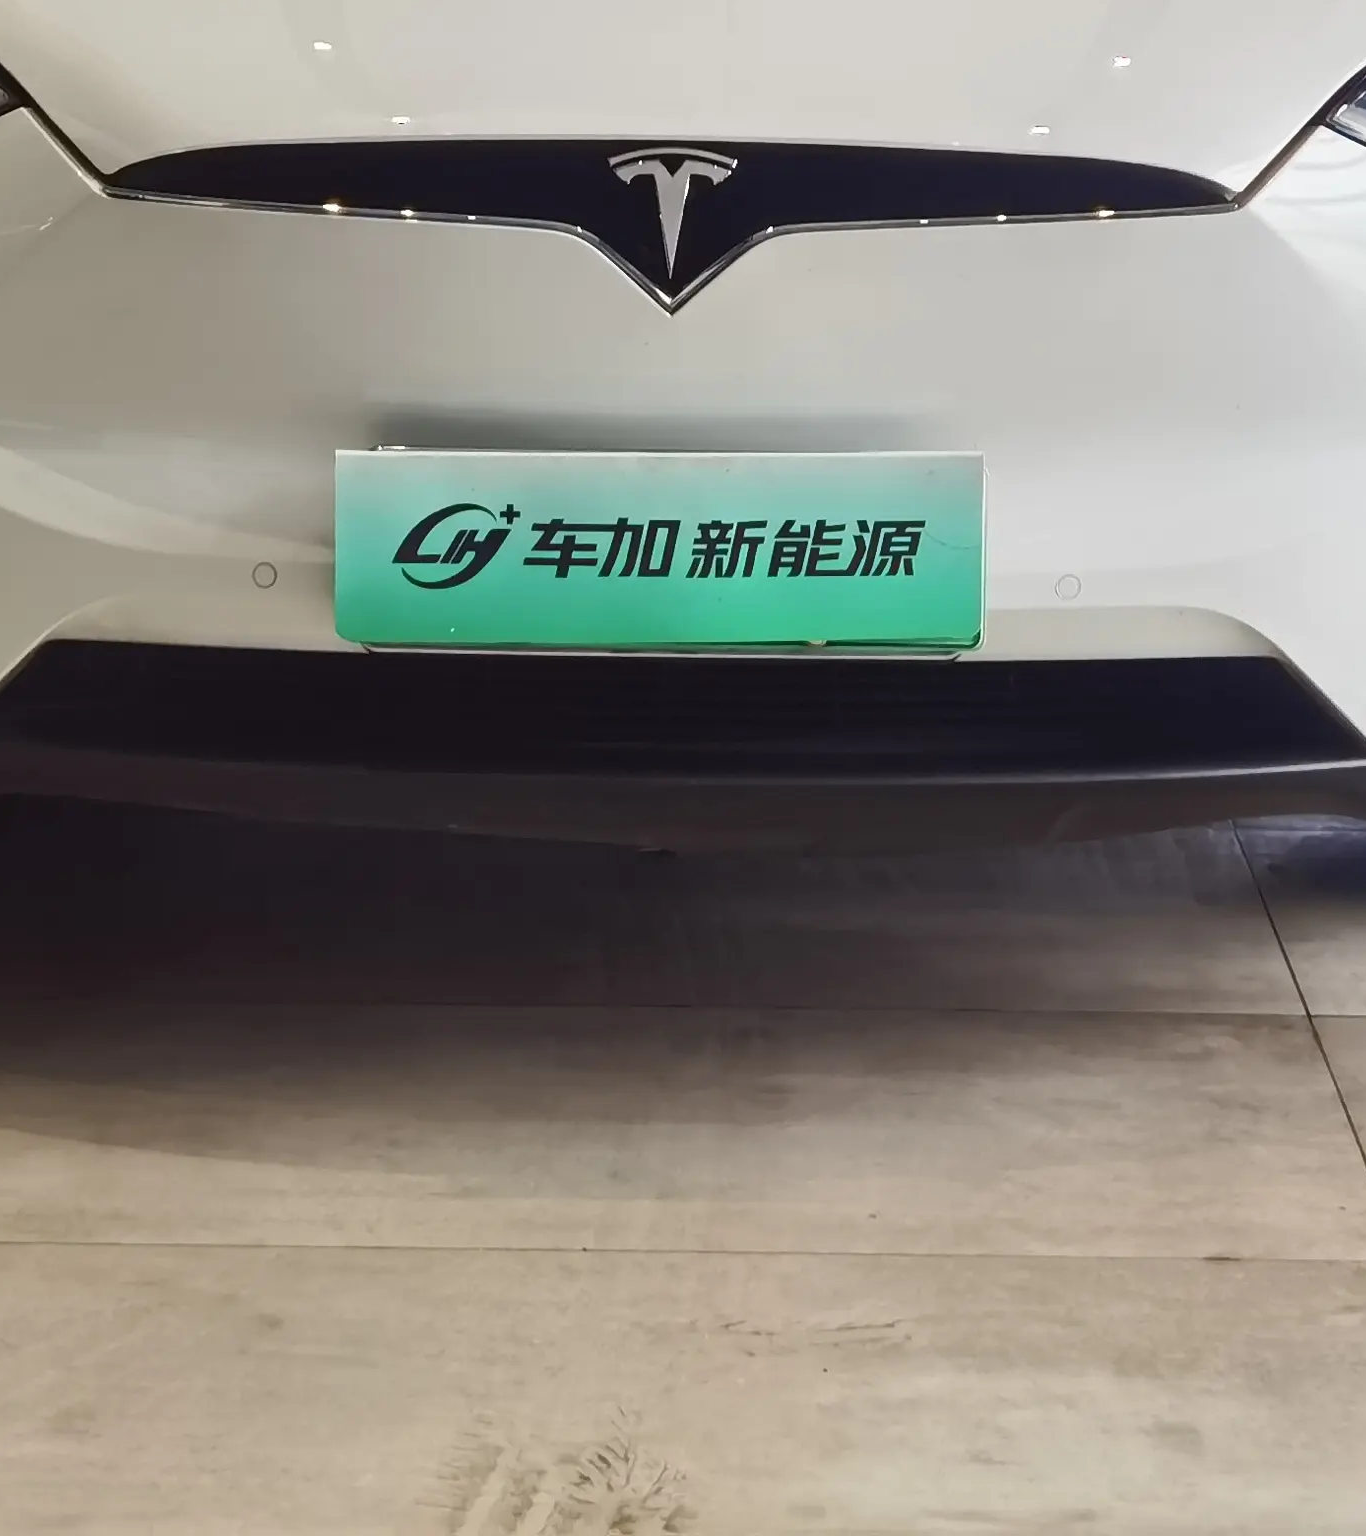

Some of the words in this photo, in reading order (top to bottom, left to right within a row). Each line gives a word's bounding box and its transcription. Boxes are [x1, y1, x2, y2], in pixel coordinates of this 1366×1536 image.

[523, 517, 926, 579] 车加新能源
